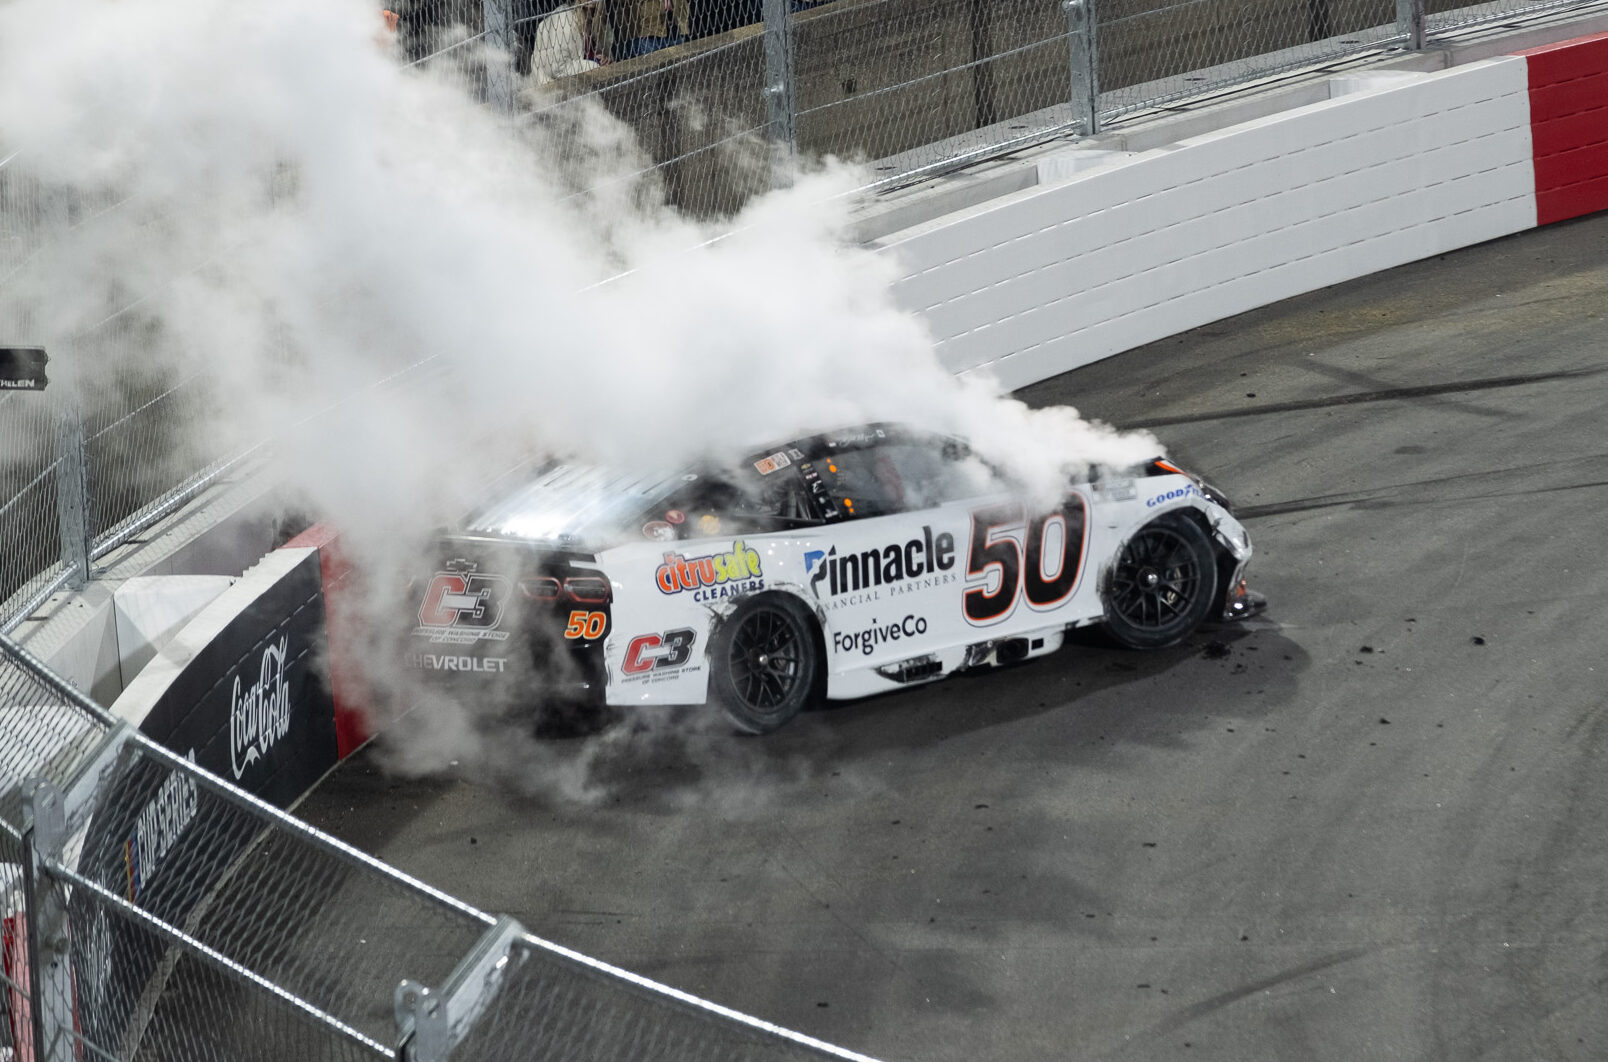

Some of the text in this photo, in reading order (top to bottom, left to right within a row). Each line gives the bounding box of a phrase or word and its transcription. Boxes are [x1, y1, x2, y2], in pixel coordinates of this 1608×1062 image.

[656, 540, 763, 595] citrusafe
[804, 525, 955, 600] Pinnacle
[962, 484, 1093, 628] 50
[694, 579, 765, 602] CLEANERS
[890, 573, 957, 597] PARTNERS
[564, 611, 606, 639] 50
[834, 614, 927, 656] ForgiveCo
[405, 654, 507, 672] HEVROLET
[621, 626, 697, 676] C3
